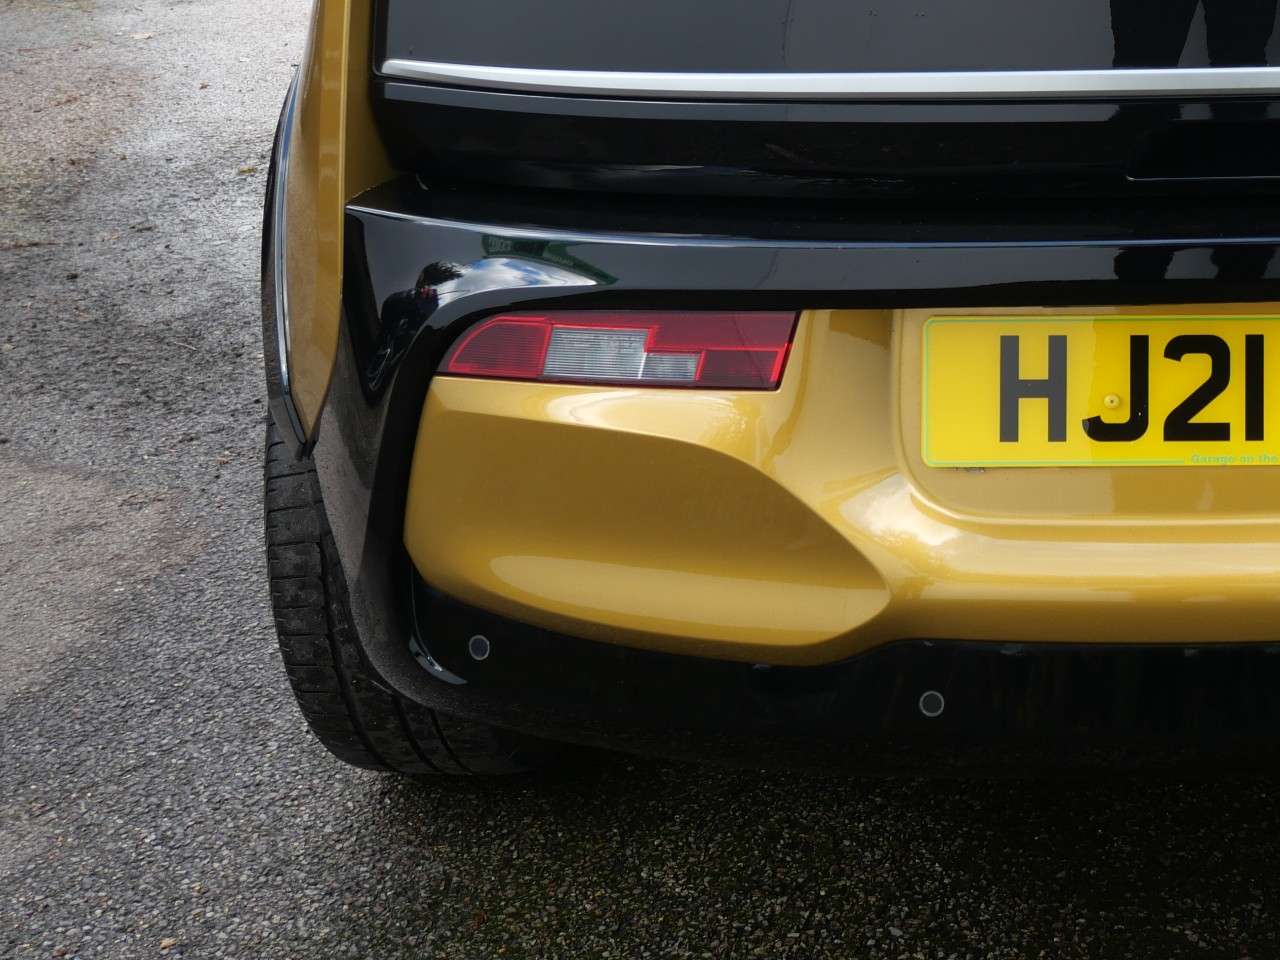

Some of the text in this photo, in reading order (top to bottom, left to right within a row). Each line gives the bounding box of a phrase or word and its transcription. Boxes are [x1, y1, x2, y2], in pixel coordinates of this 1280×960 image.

[998, 333, 1266, 443] HJ21
[1191, 453, 1235, 464] Garage
[1239, 454, 1255, 464] on
[1259, 453, 1279, 464] the
